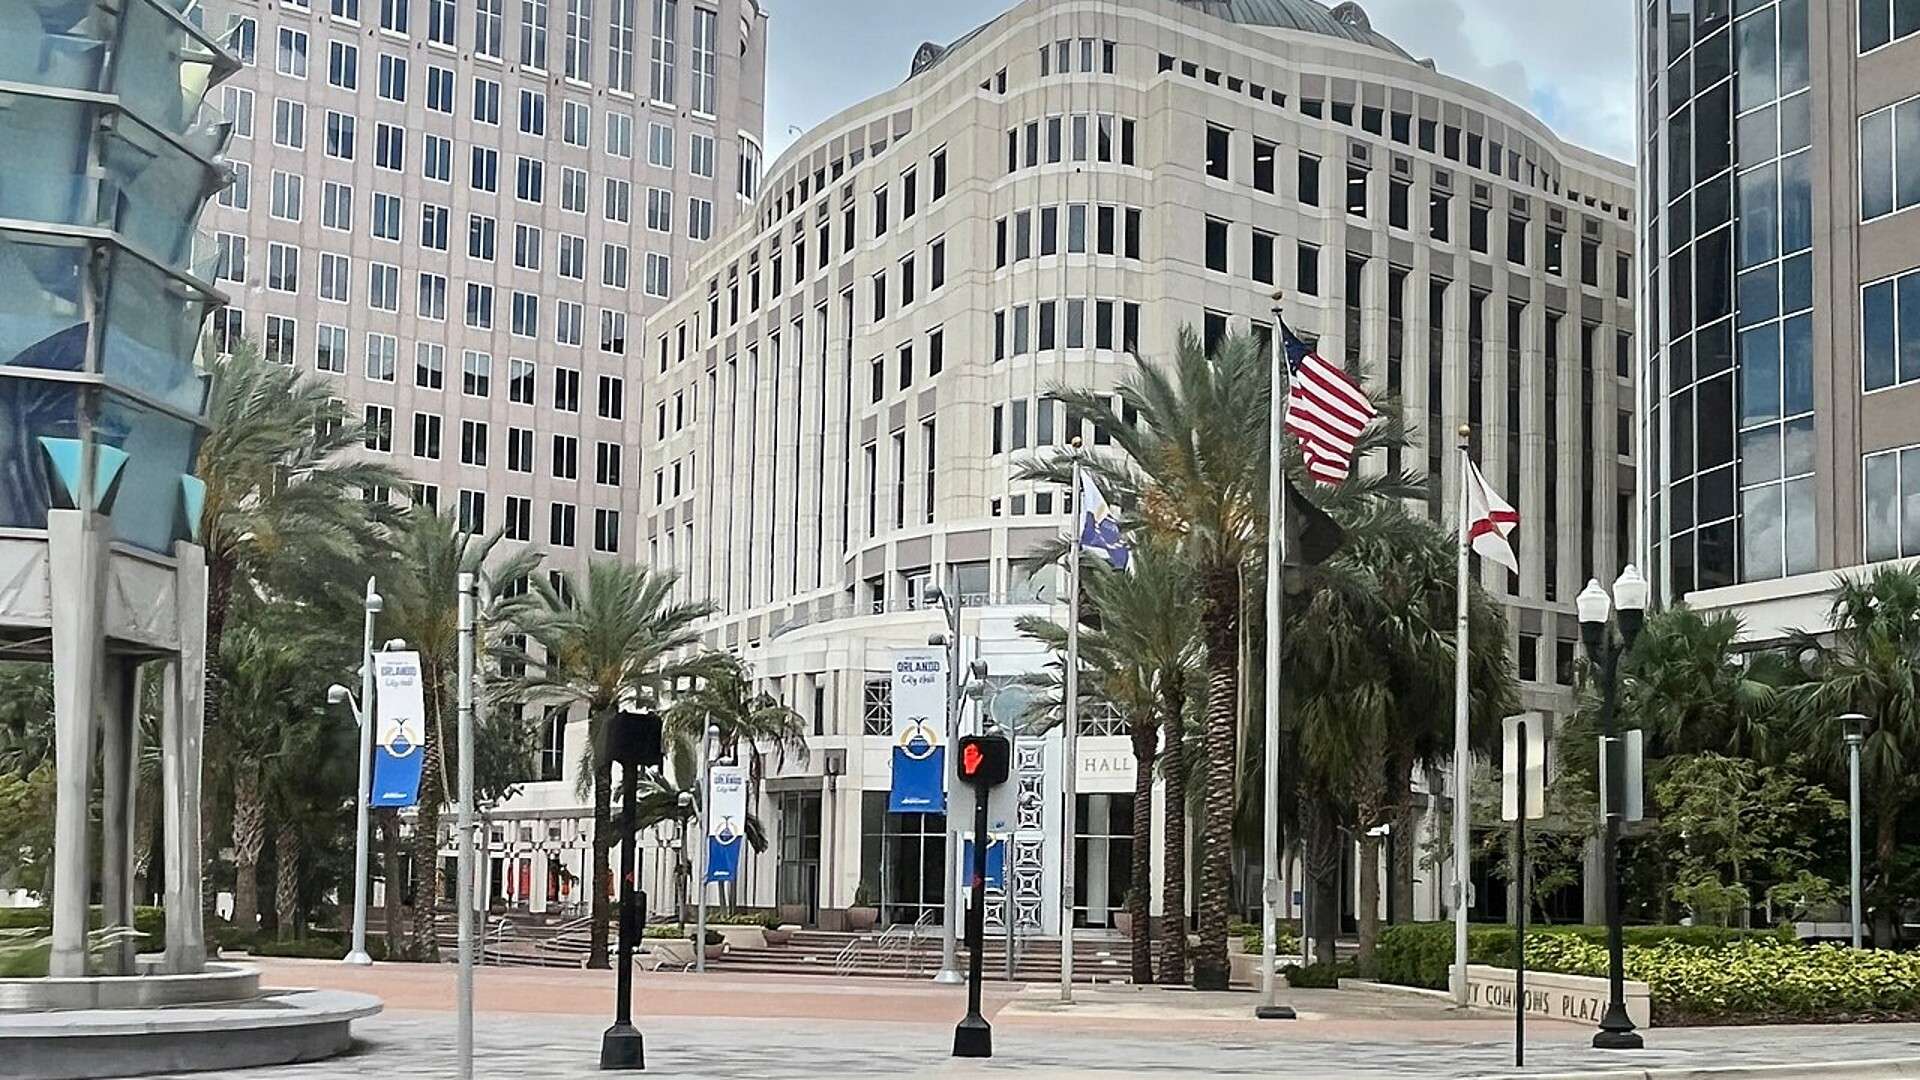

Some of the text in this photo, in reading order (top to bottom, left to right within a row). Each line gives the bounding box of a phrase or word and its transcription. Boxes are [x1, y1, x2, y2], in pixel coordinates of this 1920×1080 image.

[897, 661, 940, 672] ORLANDO
[1085, 758, 1132, 771] HALL
[1486, 984, 1550, 1014] COMONS
